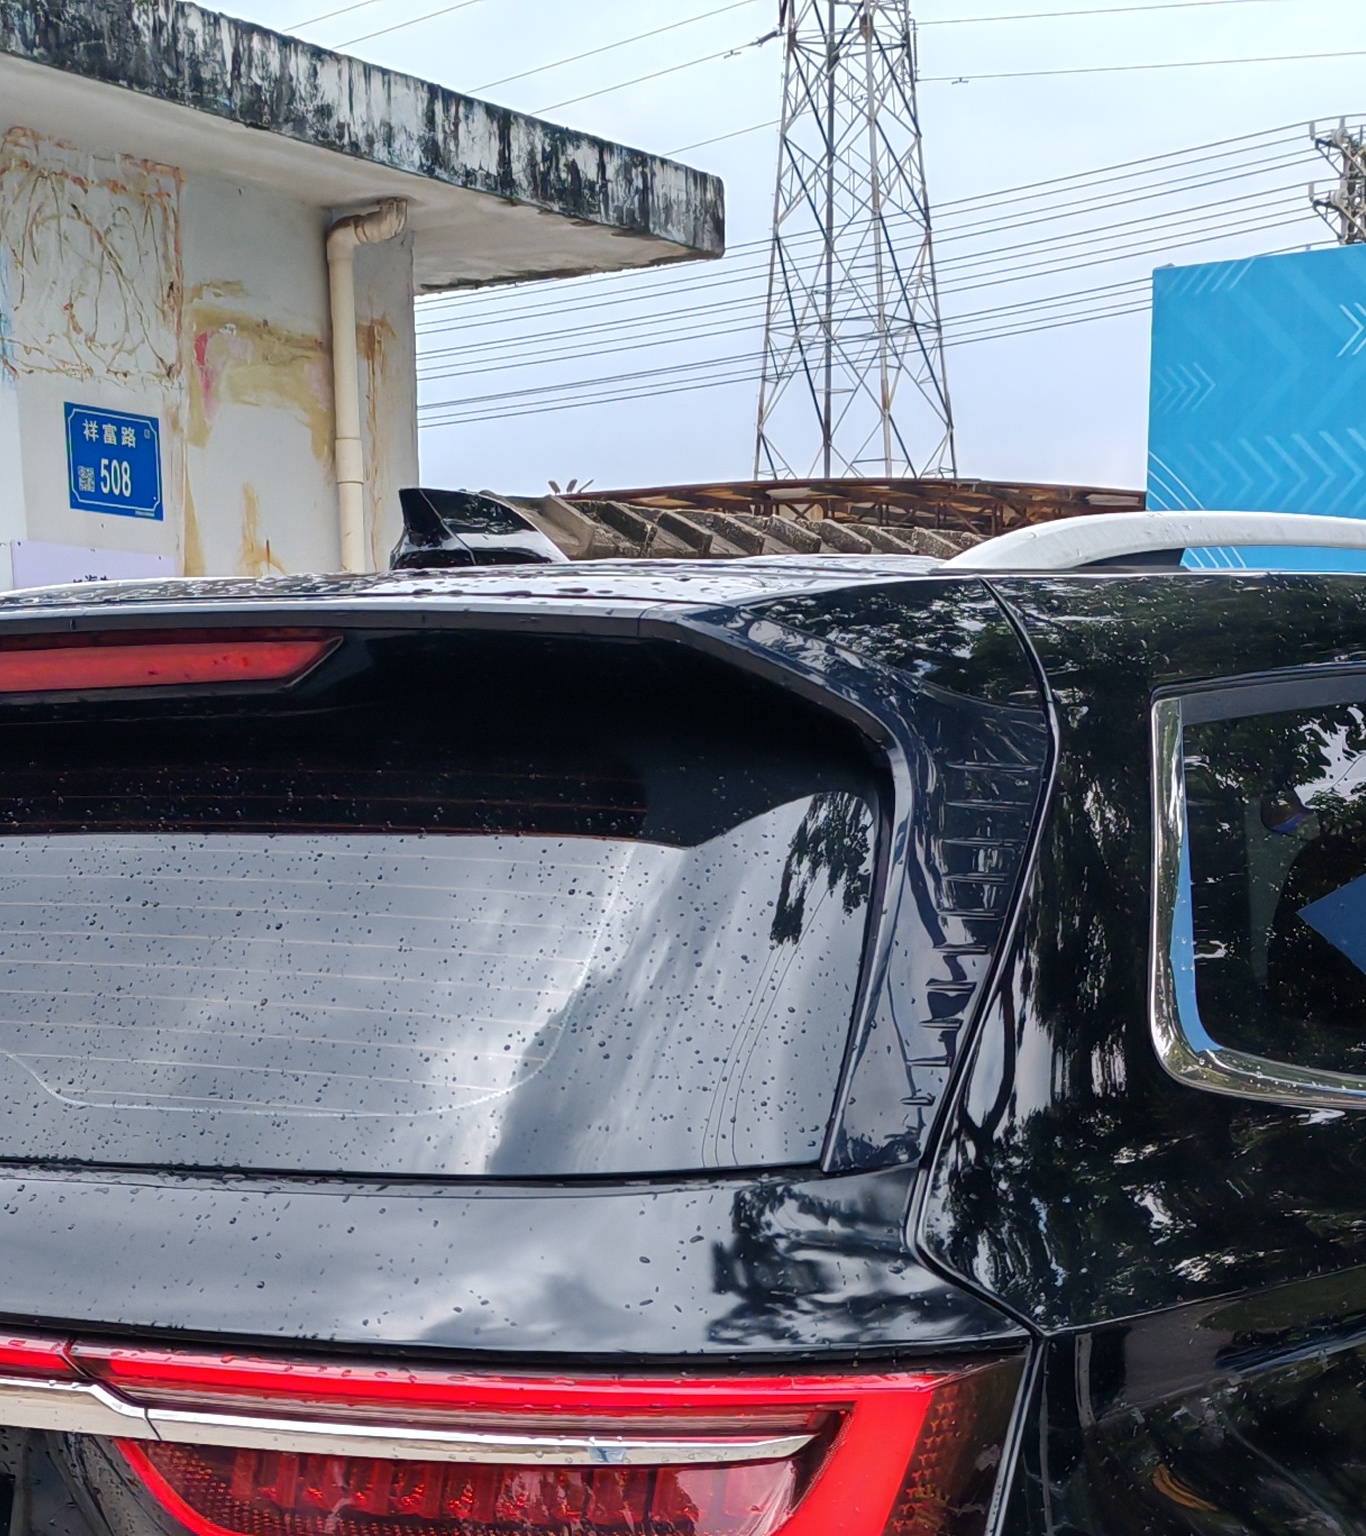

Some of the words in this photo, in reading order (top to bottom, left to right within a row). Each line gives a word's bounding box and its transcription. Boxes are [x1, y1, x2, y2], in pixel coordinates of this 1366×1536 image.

[82, 419, 137, 448] 祥富路
[100, 458, 132, 497] 508
